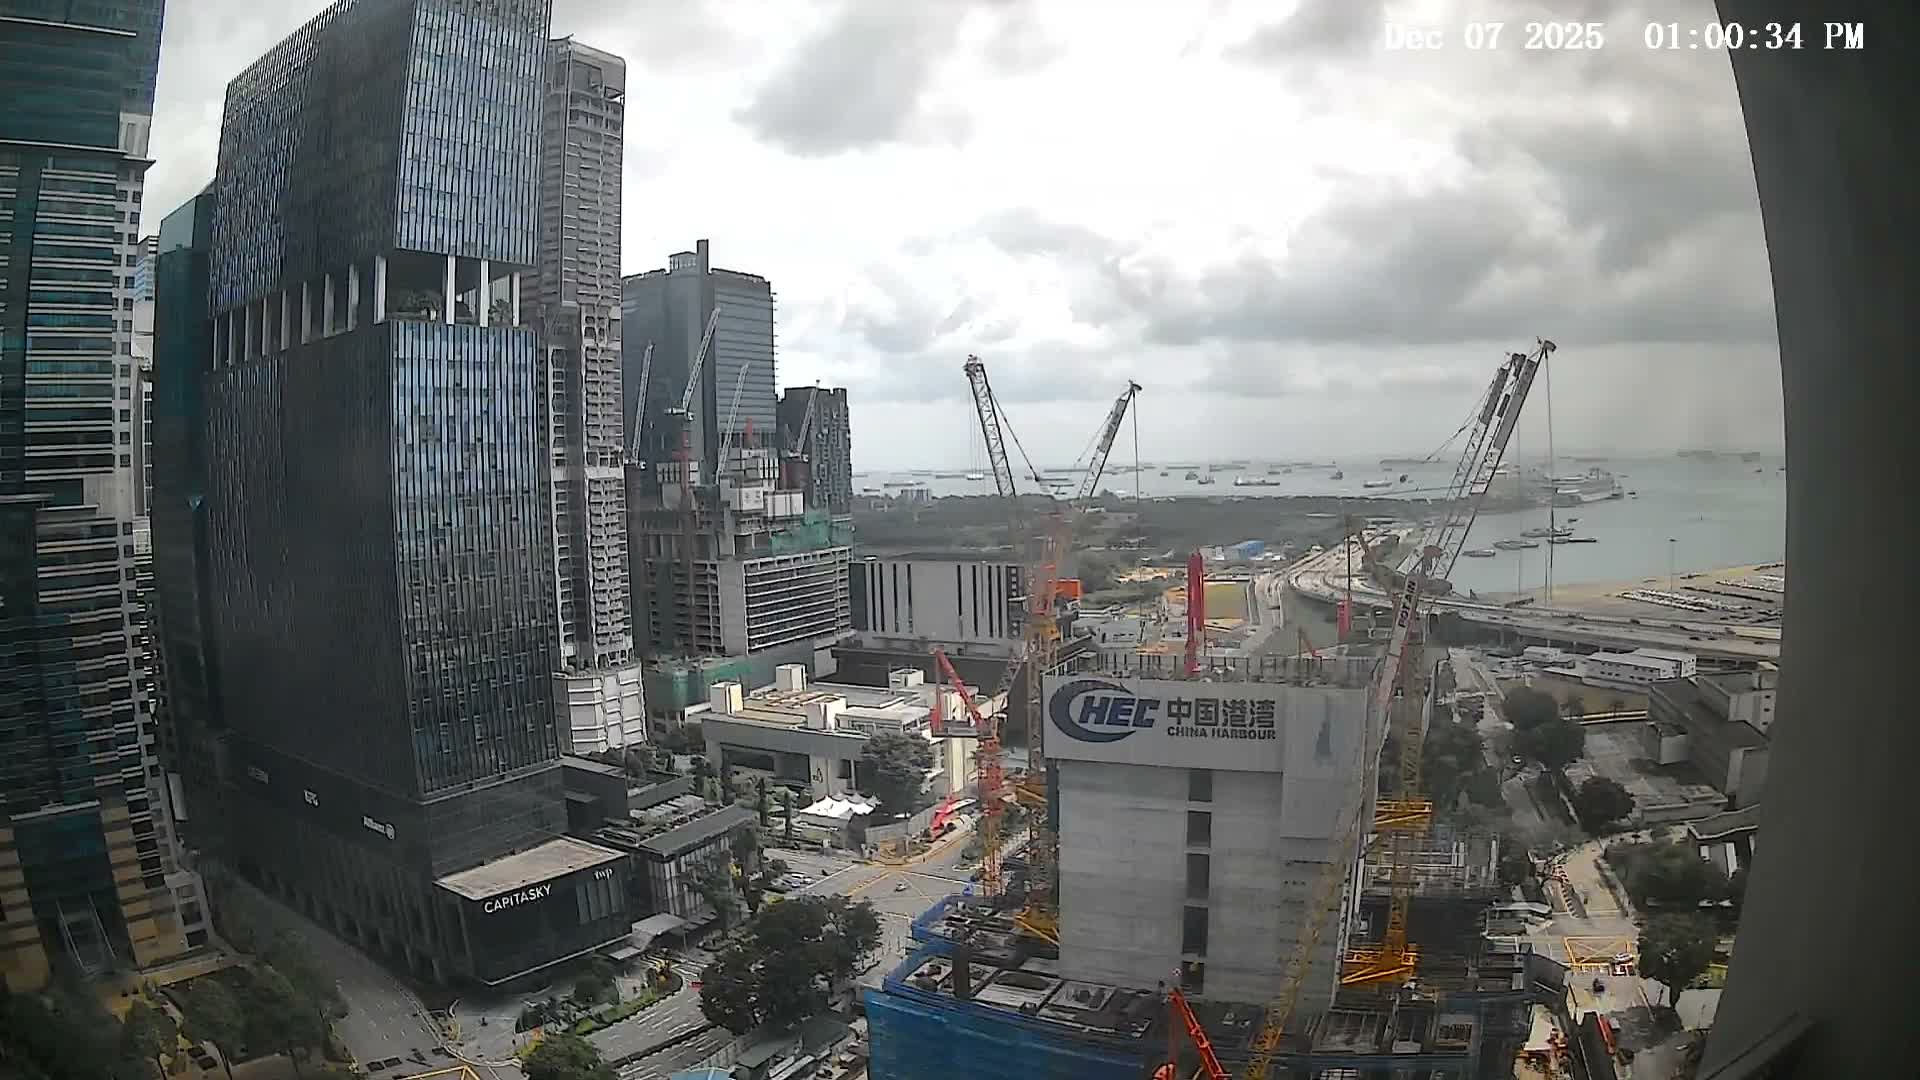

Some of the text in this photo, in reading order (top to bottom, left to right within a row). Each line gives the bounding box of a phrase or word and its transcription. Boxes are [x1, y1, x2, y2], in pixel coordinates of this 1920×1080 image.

[1166, 697, 1276, 728] 中国港湾
[1167, 726, 1277, 740] CHINA HARBOUR
[484, 883, 551, 913] CAPITASKY
